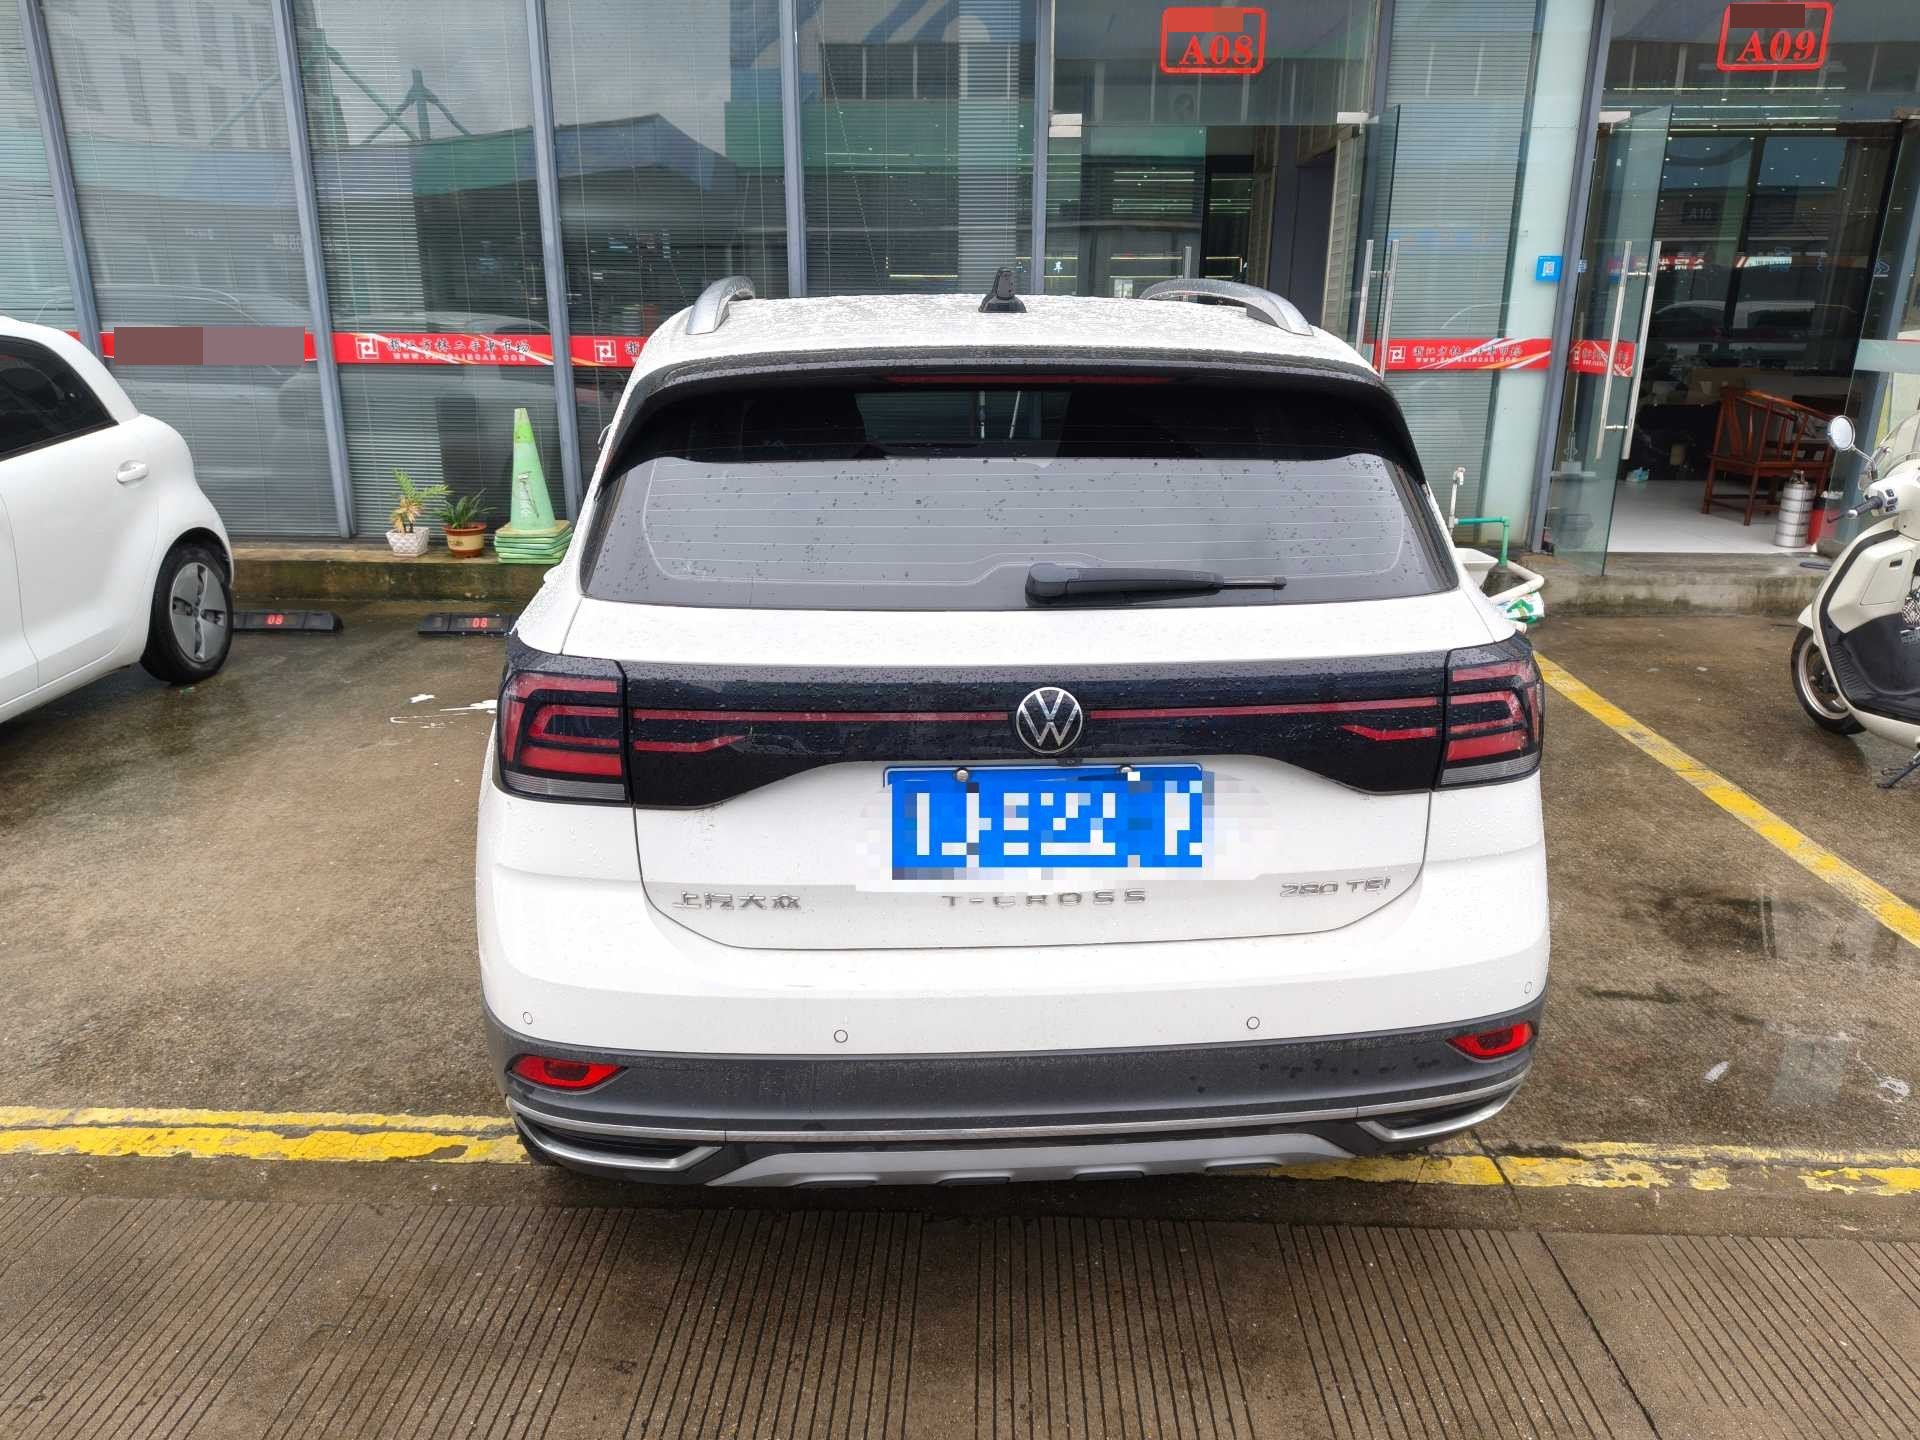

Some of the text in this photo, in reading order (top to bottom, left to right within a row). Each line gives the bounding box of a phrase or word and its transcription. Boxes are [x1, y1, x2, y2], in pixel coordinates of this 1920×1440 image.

[1178, 34, 1253, 65] A08
[1735, 30, 1816, 62] A09
[267, 614, 284, 625] 08
[472, 617, 488, 628] 08
[940, 888, 1147, 908] T-CROSS
[1279, 881, 1339, 898] 280
